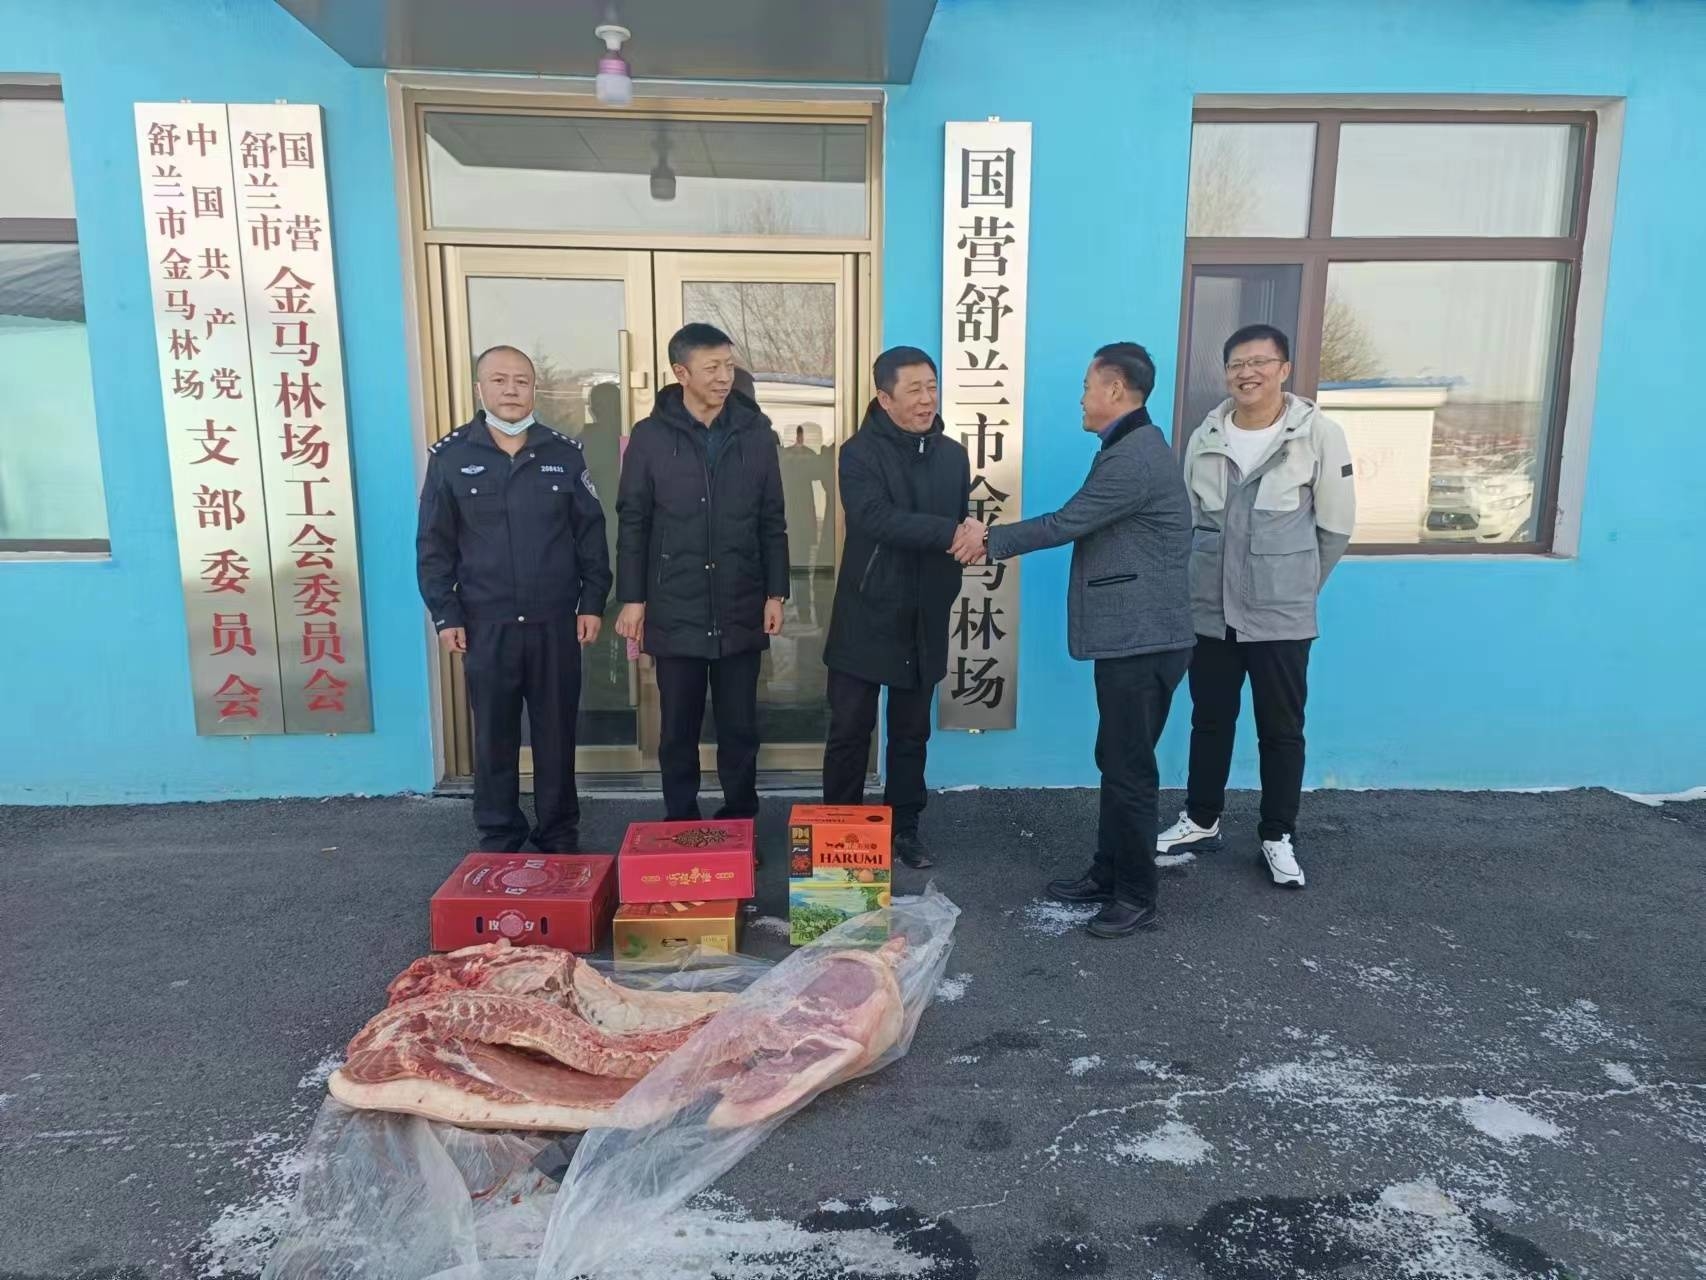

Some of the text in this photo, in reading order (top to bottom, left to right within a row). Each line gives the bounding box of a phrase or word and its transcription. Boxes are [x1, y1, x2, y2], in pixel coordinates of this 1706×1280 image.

[148, 121, 204, 401] 舒兰市金马林场
[187, 122, 243, 400] 中国共产党
[240, 131, 283, 251] 舒兰市
[278, 131, 322, 251] 国营
[186, 419, 263, 719] 支部委员会
[264, 265, 348, 712] 金马林场工会委员会
[820, 853, 883, 865] HARUMI
